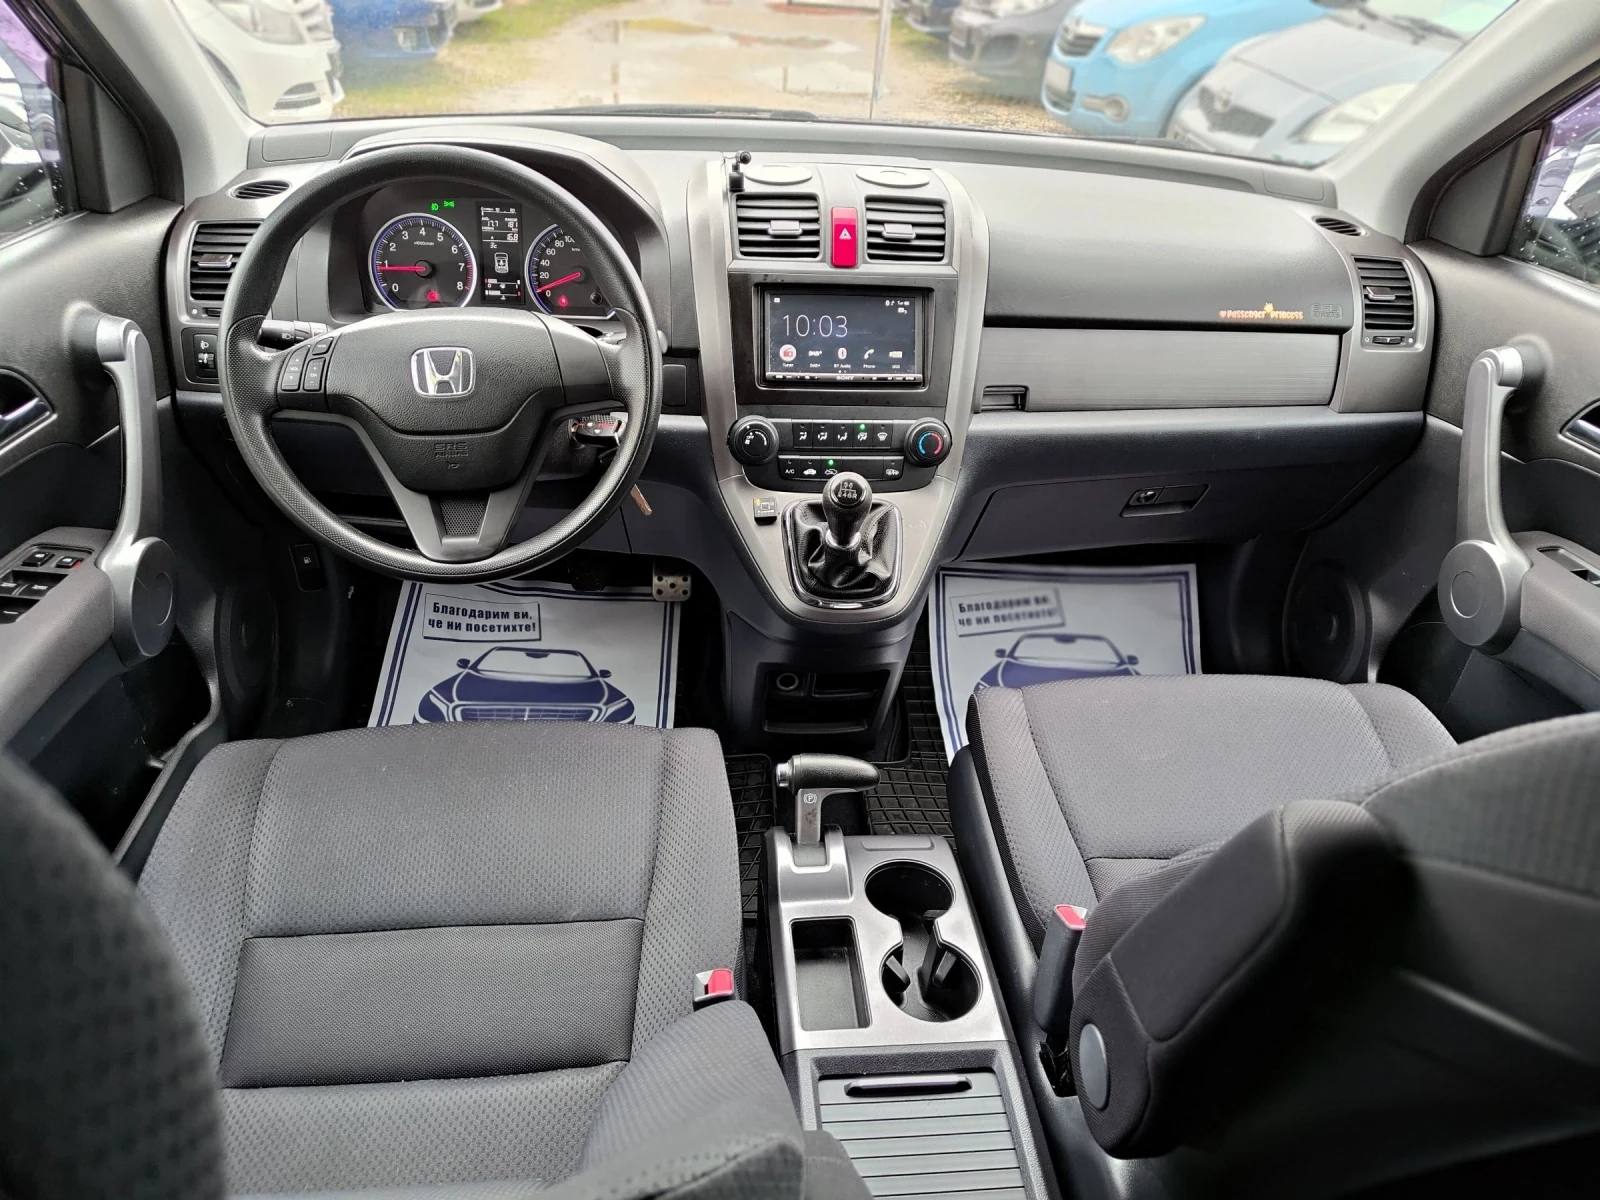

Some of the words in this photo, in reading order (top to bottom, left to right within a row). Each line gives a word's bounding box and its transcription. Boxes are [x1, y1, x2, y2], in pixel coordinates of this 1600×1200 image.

[402, 231, 409, 240] 3
[419, 227, 426, 236] 4
[437, 233, 444, 242] 5
[389, 242, 397, 252] 2
[554, 239, 565, 248] 80
[451, 245, 458, 254] 6
[546, 248, 556, 256] 60
[458, 263, 465, 272] 7
[539, 271, 550, 279] 20
[392, 283, 399, 292] 0
[456, 281, 464, 291] 8
[545, 289, 552, 297] 0
[782, 314, 848, 338] 10:03
[433, 602, 510, 620] Благодарим
[428, 618, 443, 629] че
[446, 620, 462, 631] ни
[465, 622, 536, 633] посетихте!
